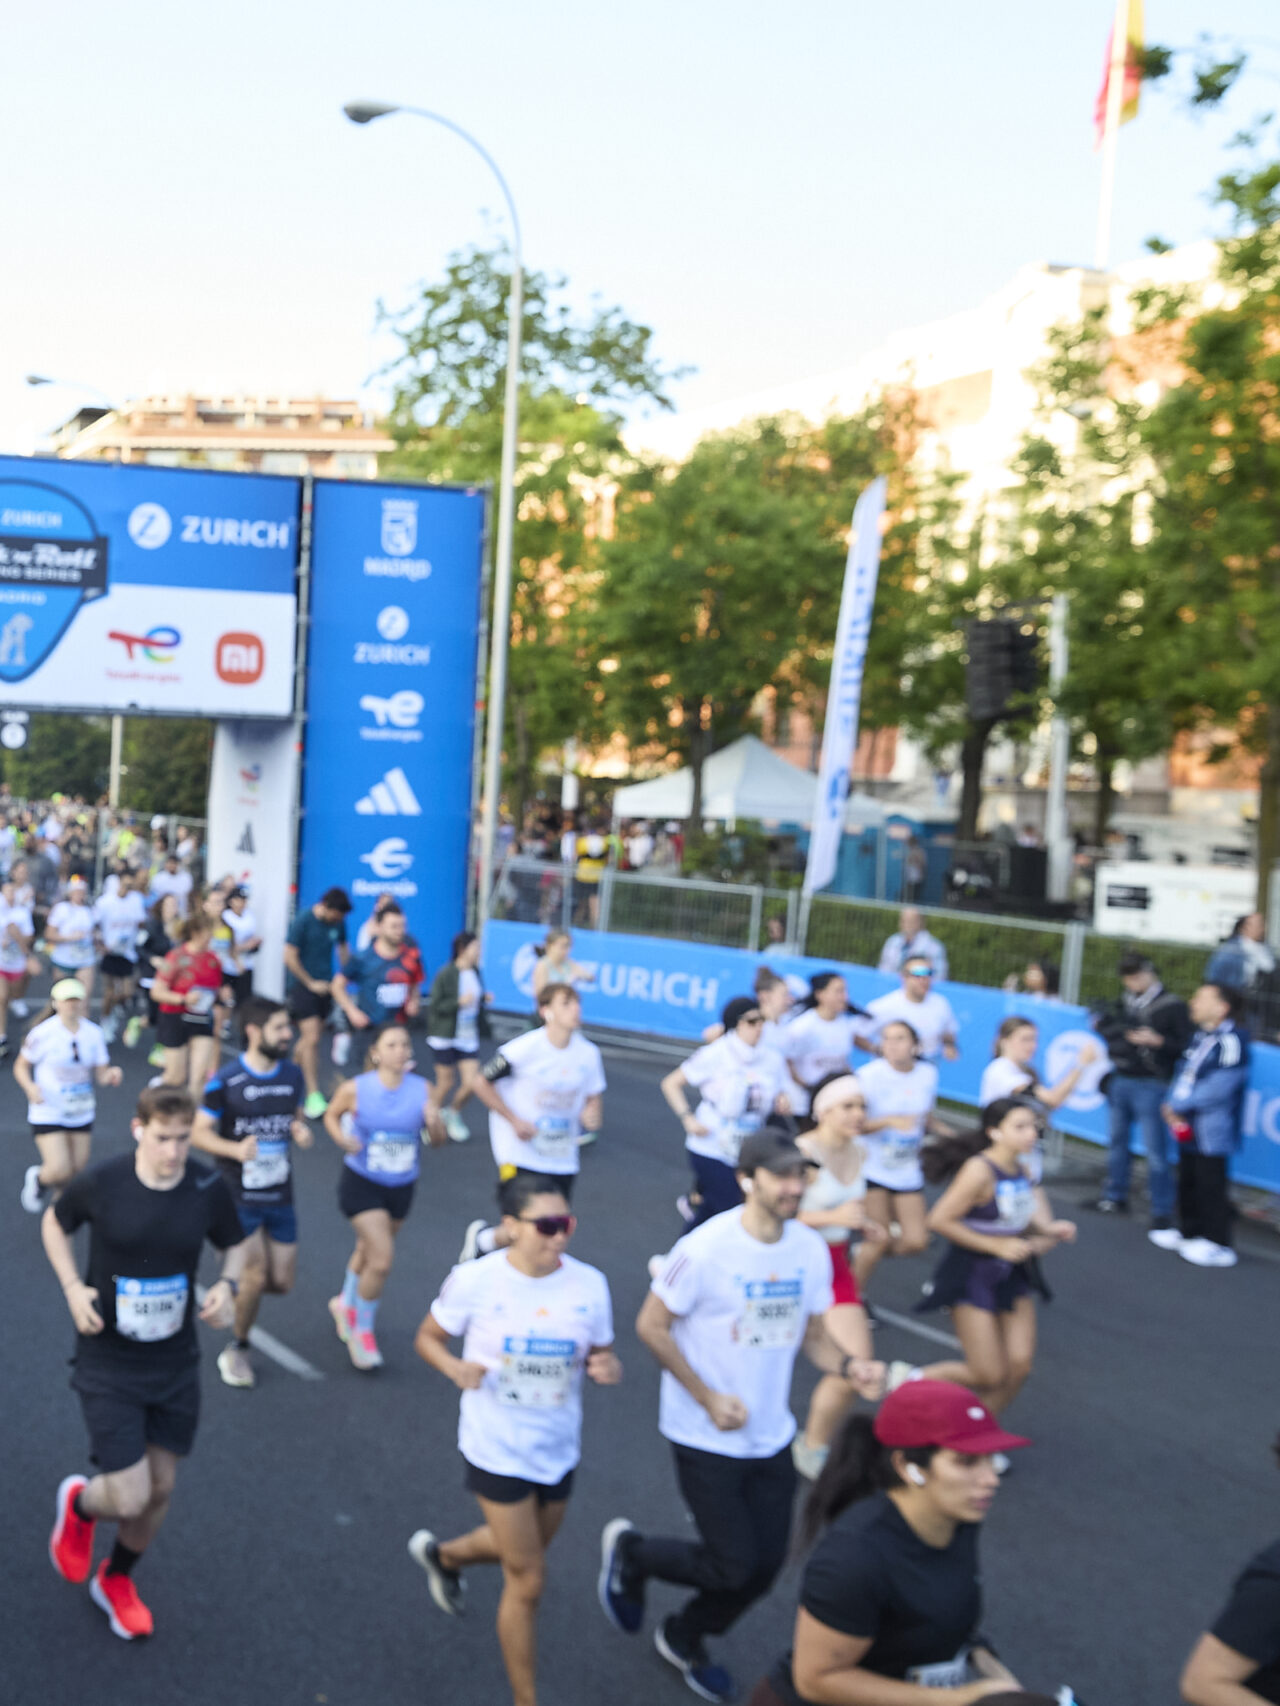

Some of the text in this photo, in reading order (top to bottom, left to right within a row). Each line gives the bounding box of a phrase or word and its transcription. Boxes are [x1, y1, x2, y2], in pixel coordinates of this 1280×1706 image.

[0, 508, 63, 529] ZURICH
[180, 515, 290, 549] ZURICH
[32, 543, 97, 569] Roll
[23, 567, 82, 582] SERIES
[353, 642, 431, 667] ZURICH
[575, 962, 718, 1011] ZURICH
